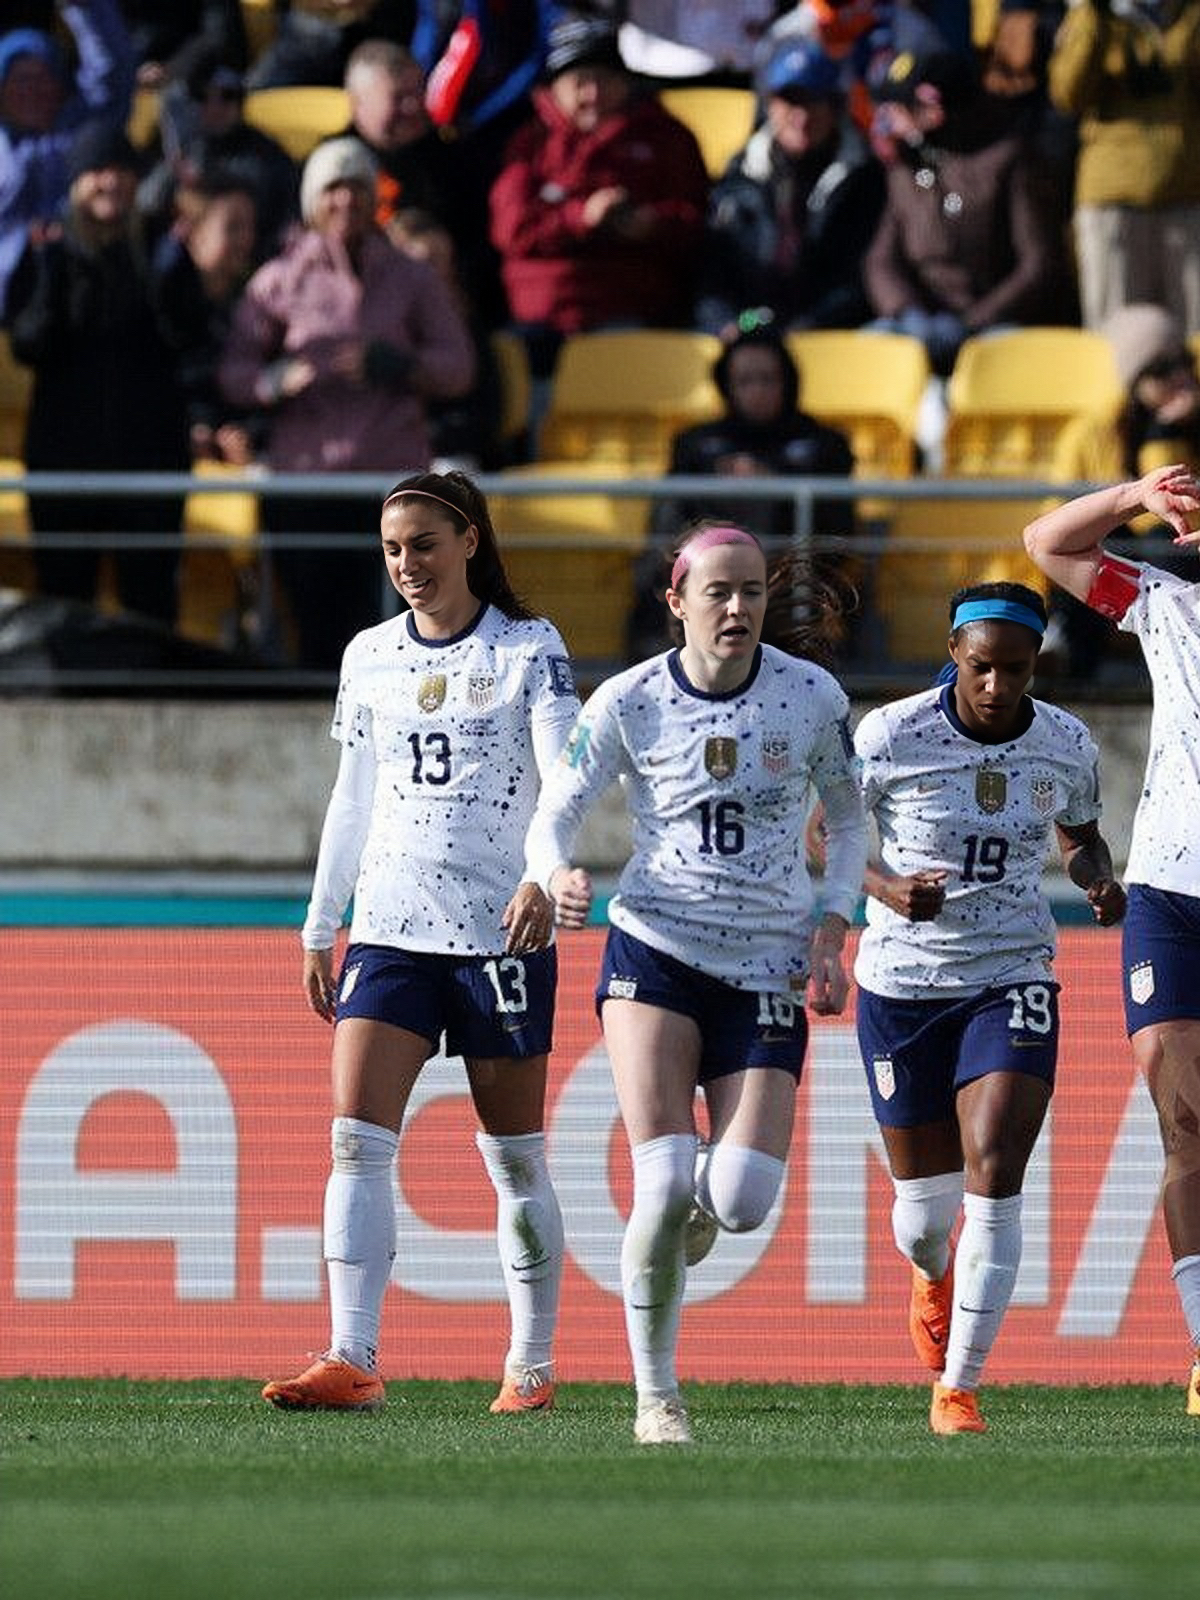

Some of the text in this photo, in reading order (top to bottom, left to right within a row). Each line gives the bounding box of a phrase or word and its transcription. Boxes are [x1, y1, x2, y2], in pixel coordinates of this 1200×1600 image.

[407, 732, 453, 786] 13
[697, 800, 745, 856] 16
[959, 834, 1009, 884] 19
[483, 957, 528, 1013] 13
[1005, 984, 1051, 1034] 19
